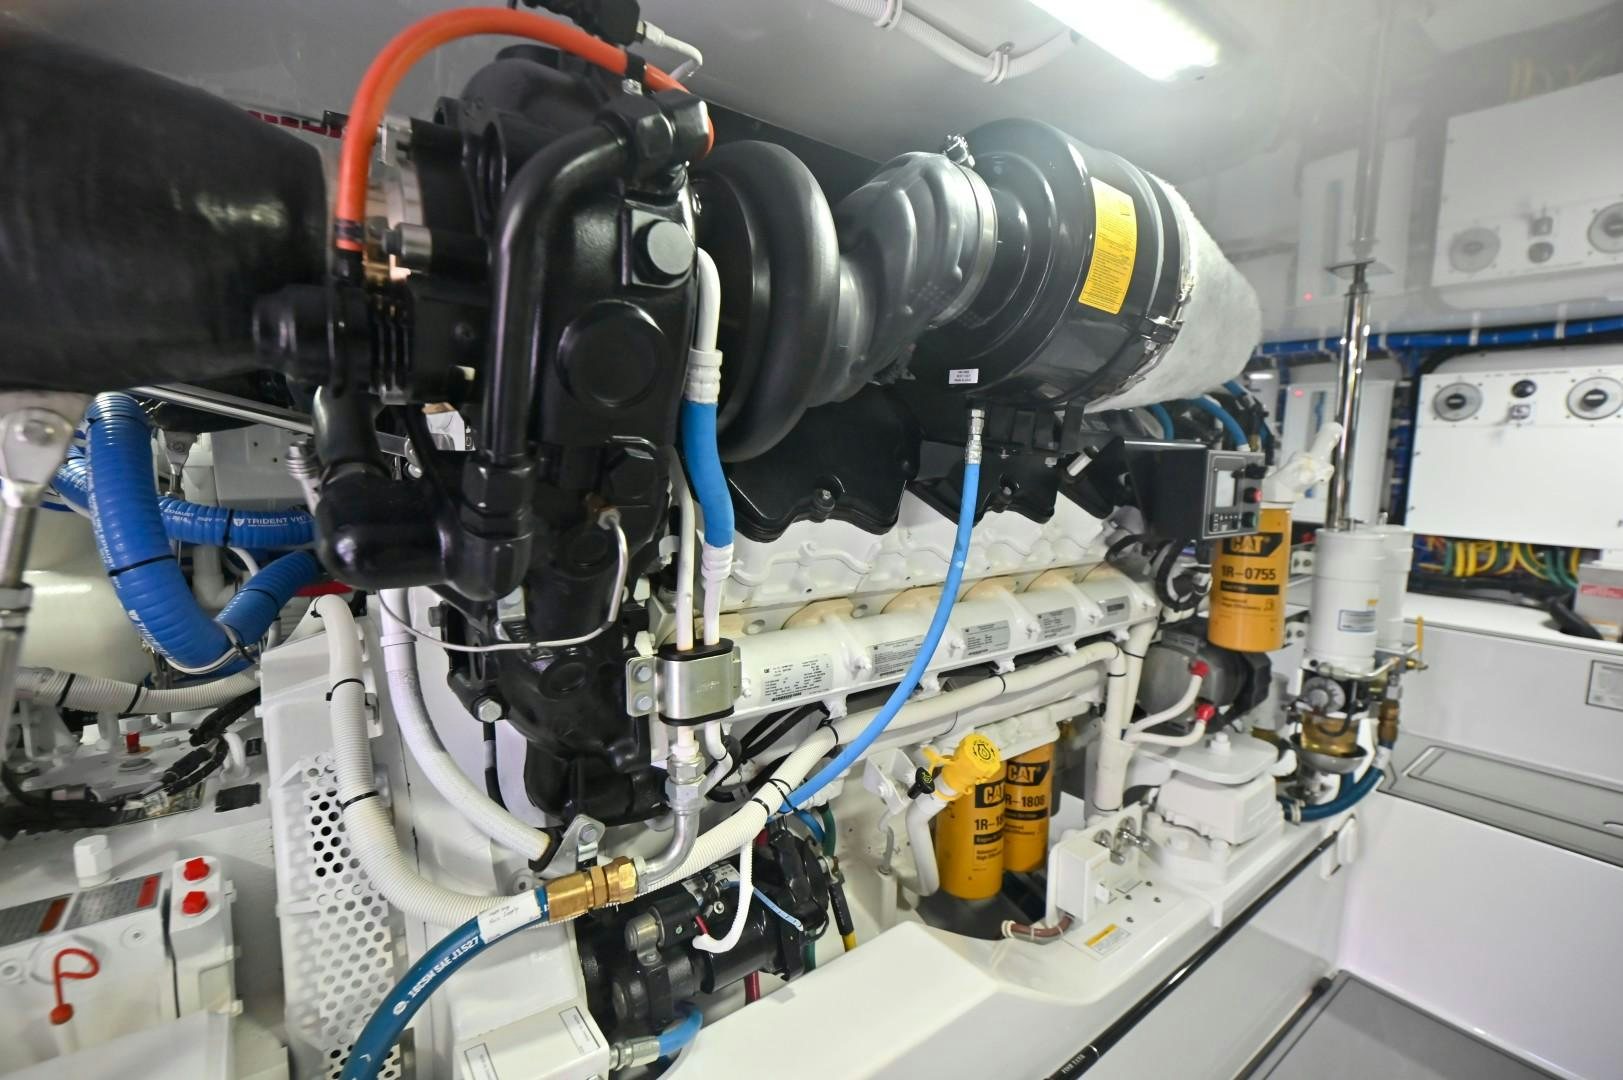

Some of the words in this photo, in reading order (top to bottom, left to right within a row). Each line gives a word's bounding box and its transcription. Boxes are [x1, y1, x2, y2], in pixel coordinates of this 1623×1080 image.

[247, 517, 288, 526] TRIDENT
[1230, 536, 1264, 554] CAT
[1008, 765, 1036, 783] CAT
[434, 958, 453, 974] SAE
[452, 936, 480, 960] J1527
